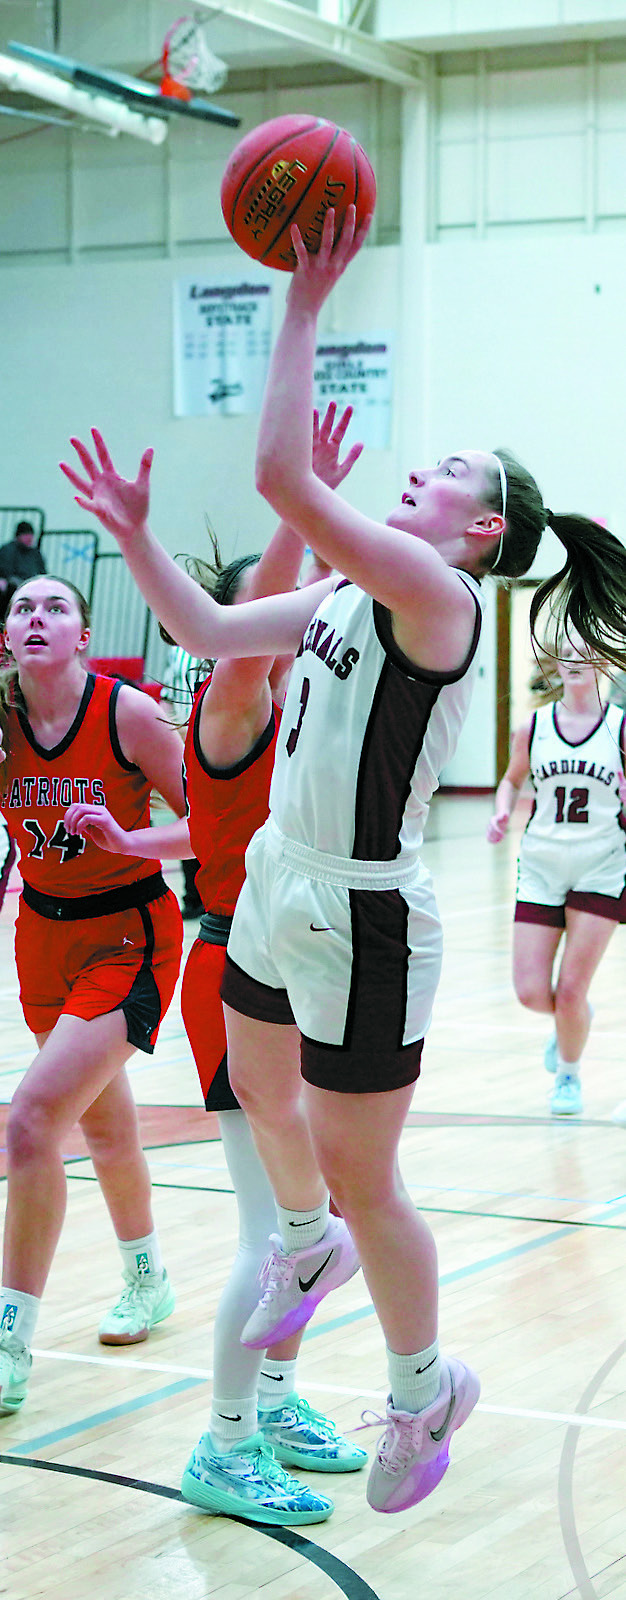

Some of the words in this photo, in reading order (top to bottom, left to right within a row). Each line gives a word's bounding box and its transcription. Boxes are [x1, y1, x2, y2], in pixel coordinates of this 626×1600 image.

[251, 158, 308, 240] LEGACY
[315, 342, 387, 358] angdon
[554, 786, 589, 823] 12
[22, 818, 87, 864] 14
